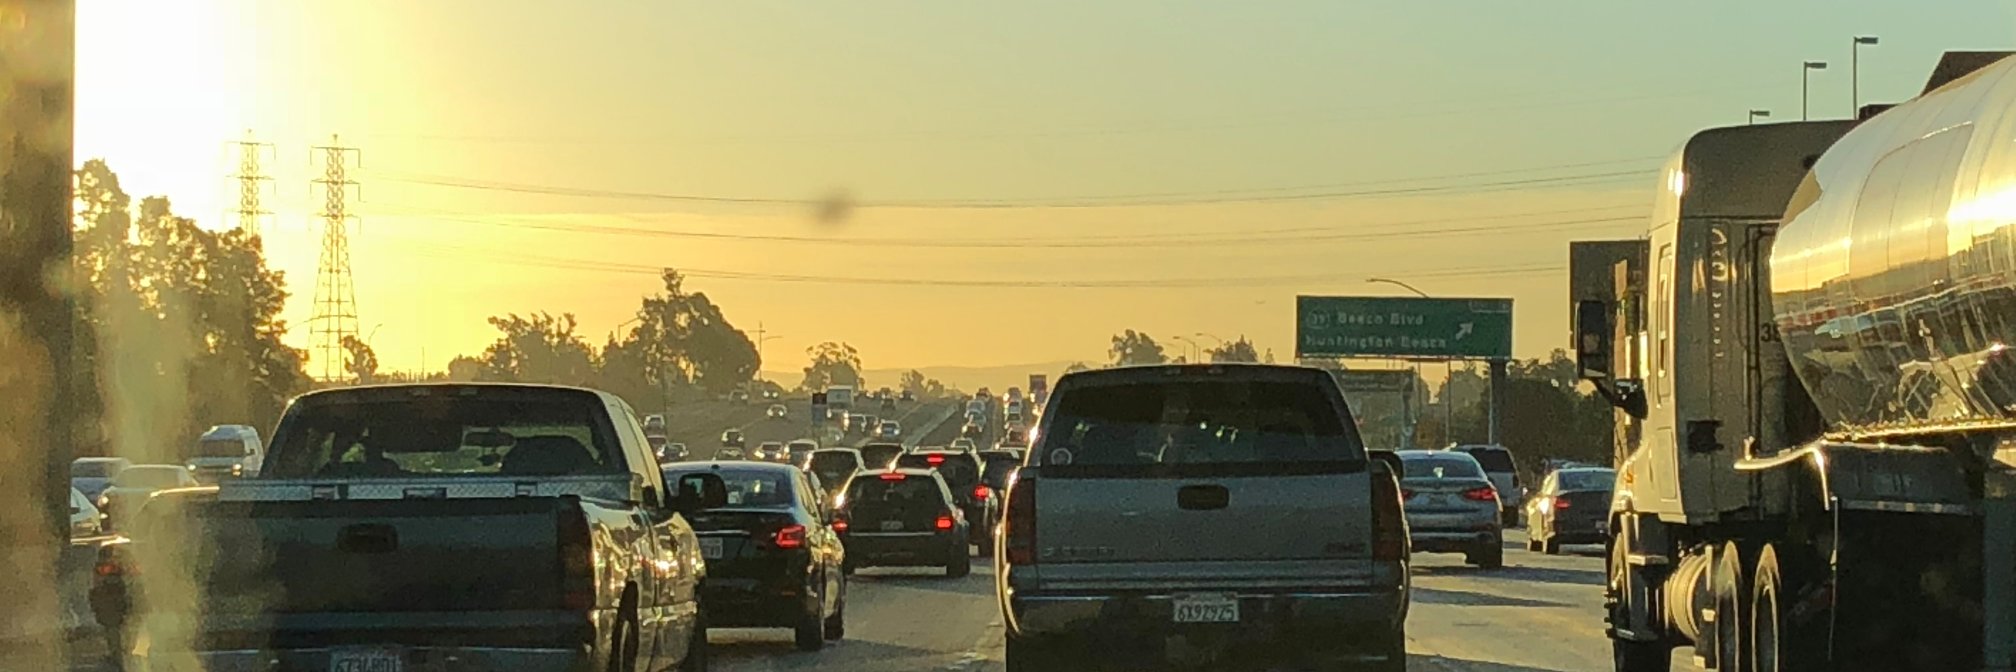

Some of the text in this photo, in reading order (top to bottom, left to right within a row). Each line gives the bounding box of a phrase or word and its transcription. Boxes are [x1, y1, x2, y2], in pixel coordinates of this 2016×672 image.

[1338, 313, 1383, 325] Beach
[1390, 313, 1424, 325] Blvd
[1305, 334, 1447, 350] Huntington Beach
